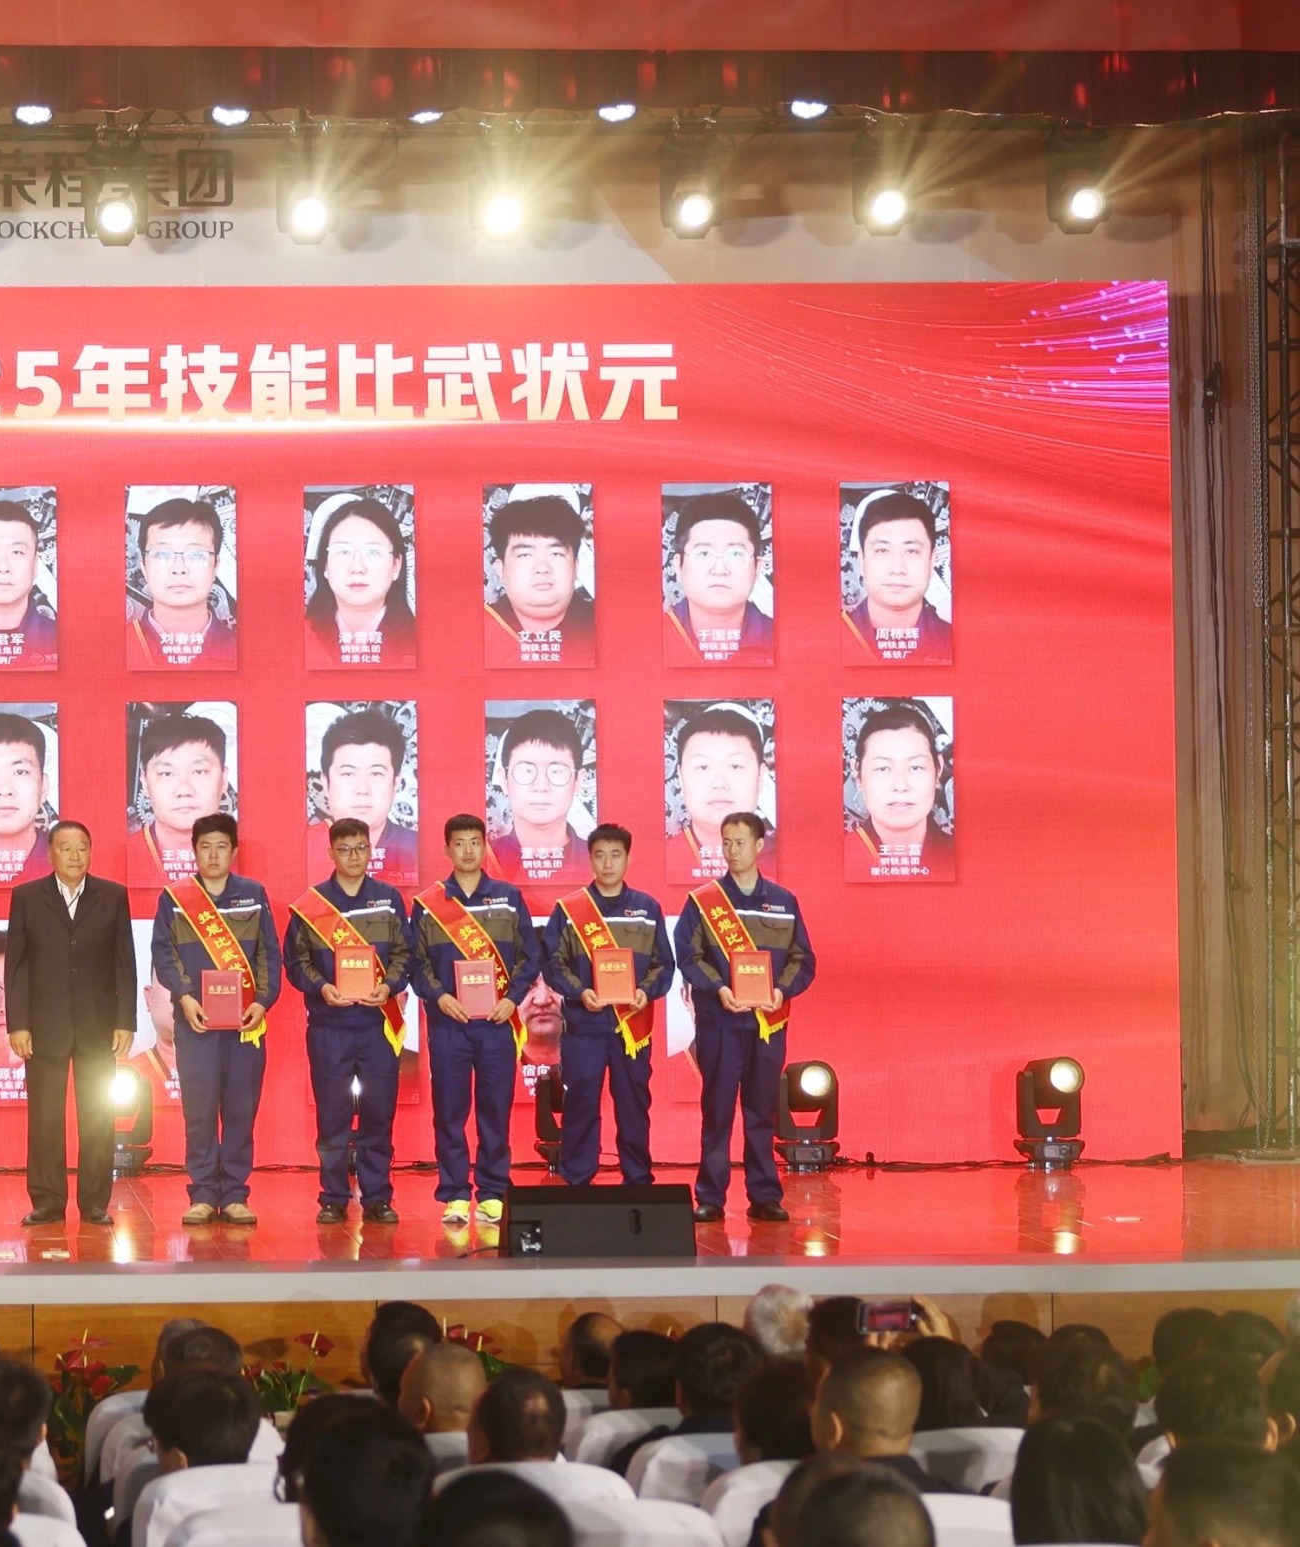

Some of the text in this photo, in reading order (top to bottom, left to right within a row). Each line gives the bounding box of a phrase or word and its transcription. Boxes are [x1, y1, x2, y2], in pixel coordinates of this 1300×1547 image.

[146, 220, 233, 239] GROUP
[341, 645, 381, 653] 钢铁集团
[520, 644, 561, 652] 钢铁集团
[699, 643, 739, 651] 钢铁集团
[877, 641, 918, 650] 钢铁集团
[162, 646, 203, 654] 钢铁集团
[522, 861, 563, 869] 钢铁集团
[880, 857, 920, 866] 钢铁集团
